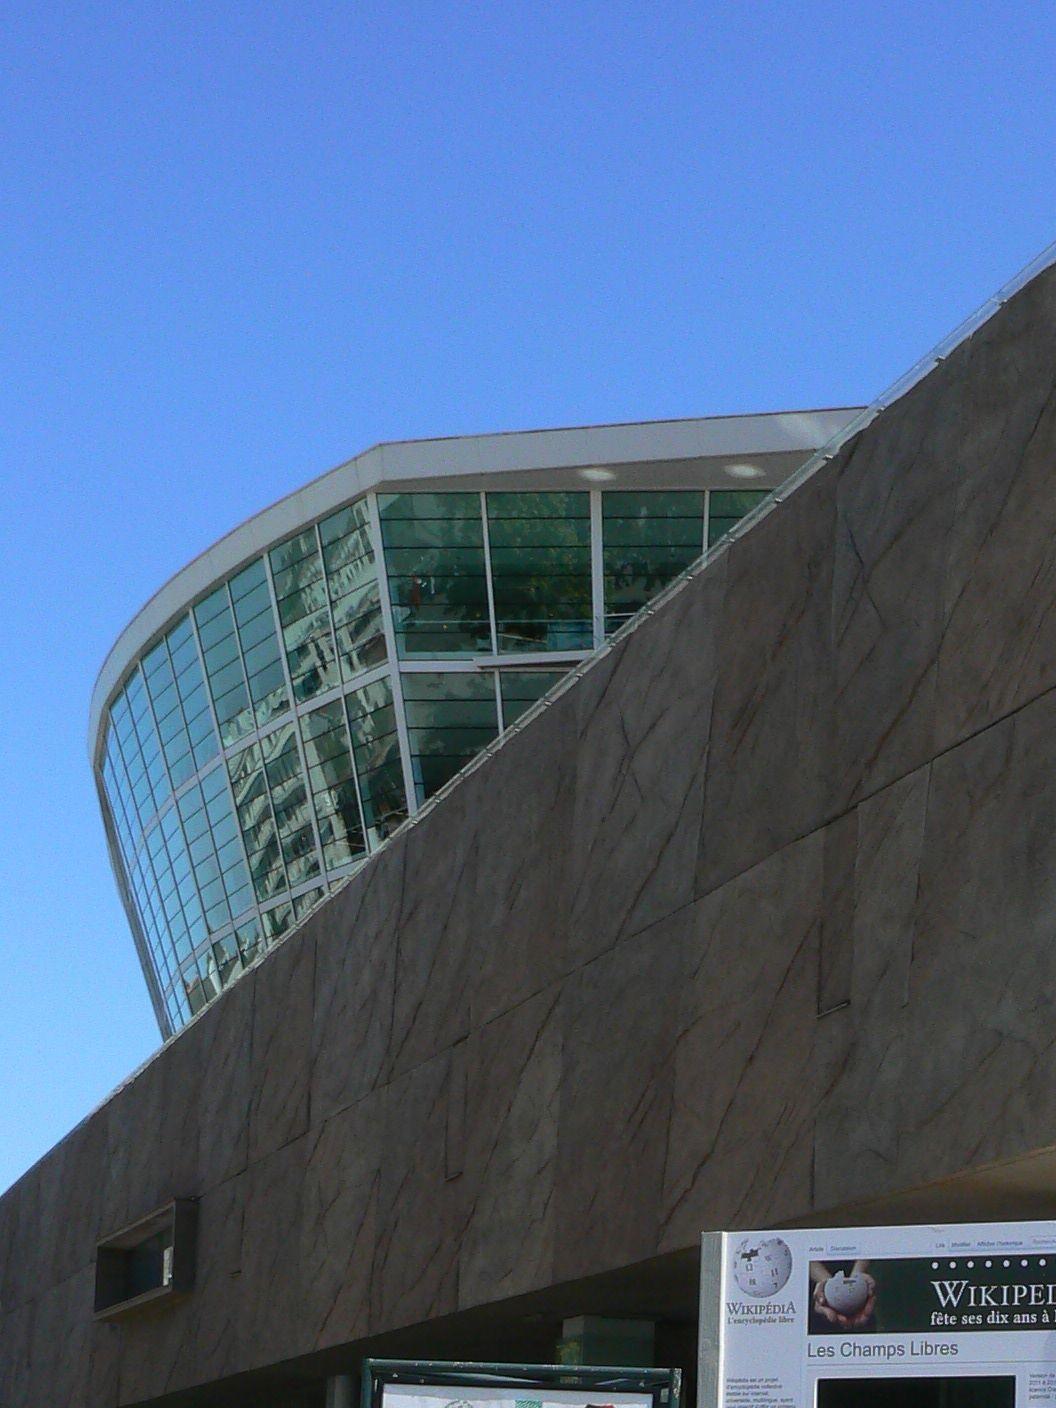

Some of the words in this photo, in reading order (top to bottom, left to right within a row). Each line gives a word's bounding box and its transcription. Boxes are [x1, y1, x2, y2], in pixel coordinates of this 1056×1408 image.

[726, 1301, 796, 1315] WIKIPÉDIA
[931, 1311, 956, 1325] fête
[961, 1313, 981, 1324] ses
[987, 1310, 1007, 1324] dix
[1013, 1312, 1036, 1323] ans
[808, 1342, 837, 1358] Les
[840, 1341, 904, 1360] Champs
[910, 1340, 958, 1356] Libres
